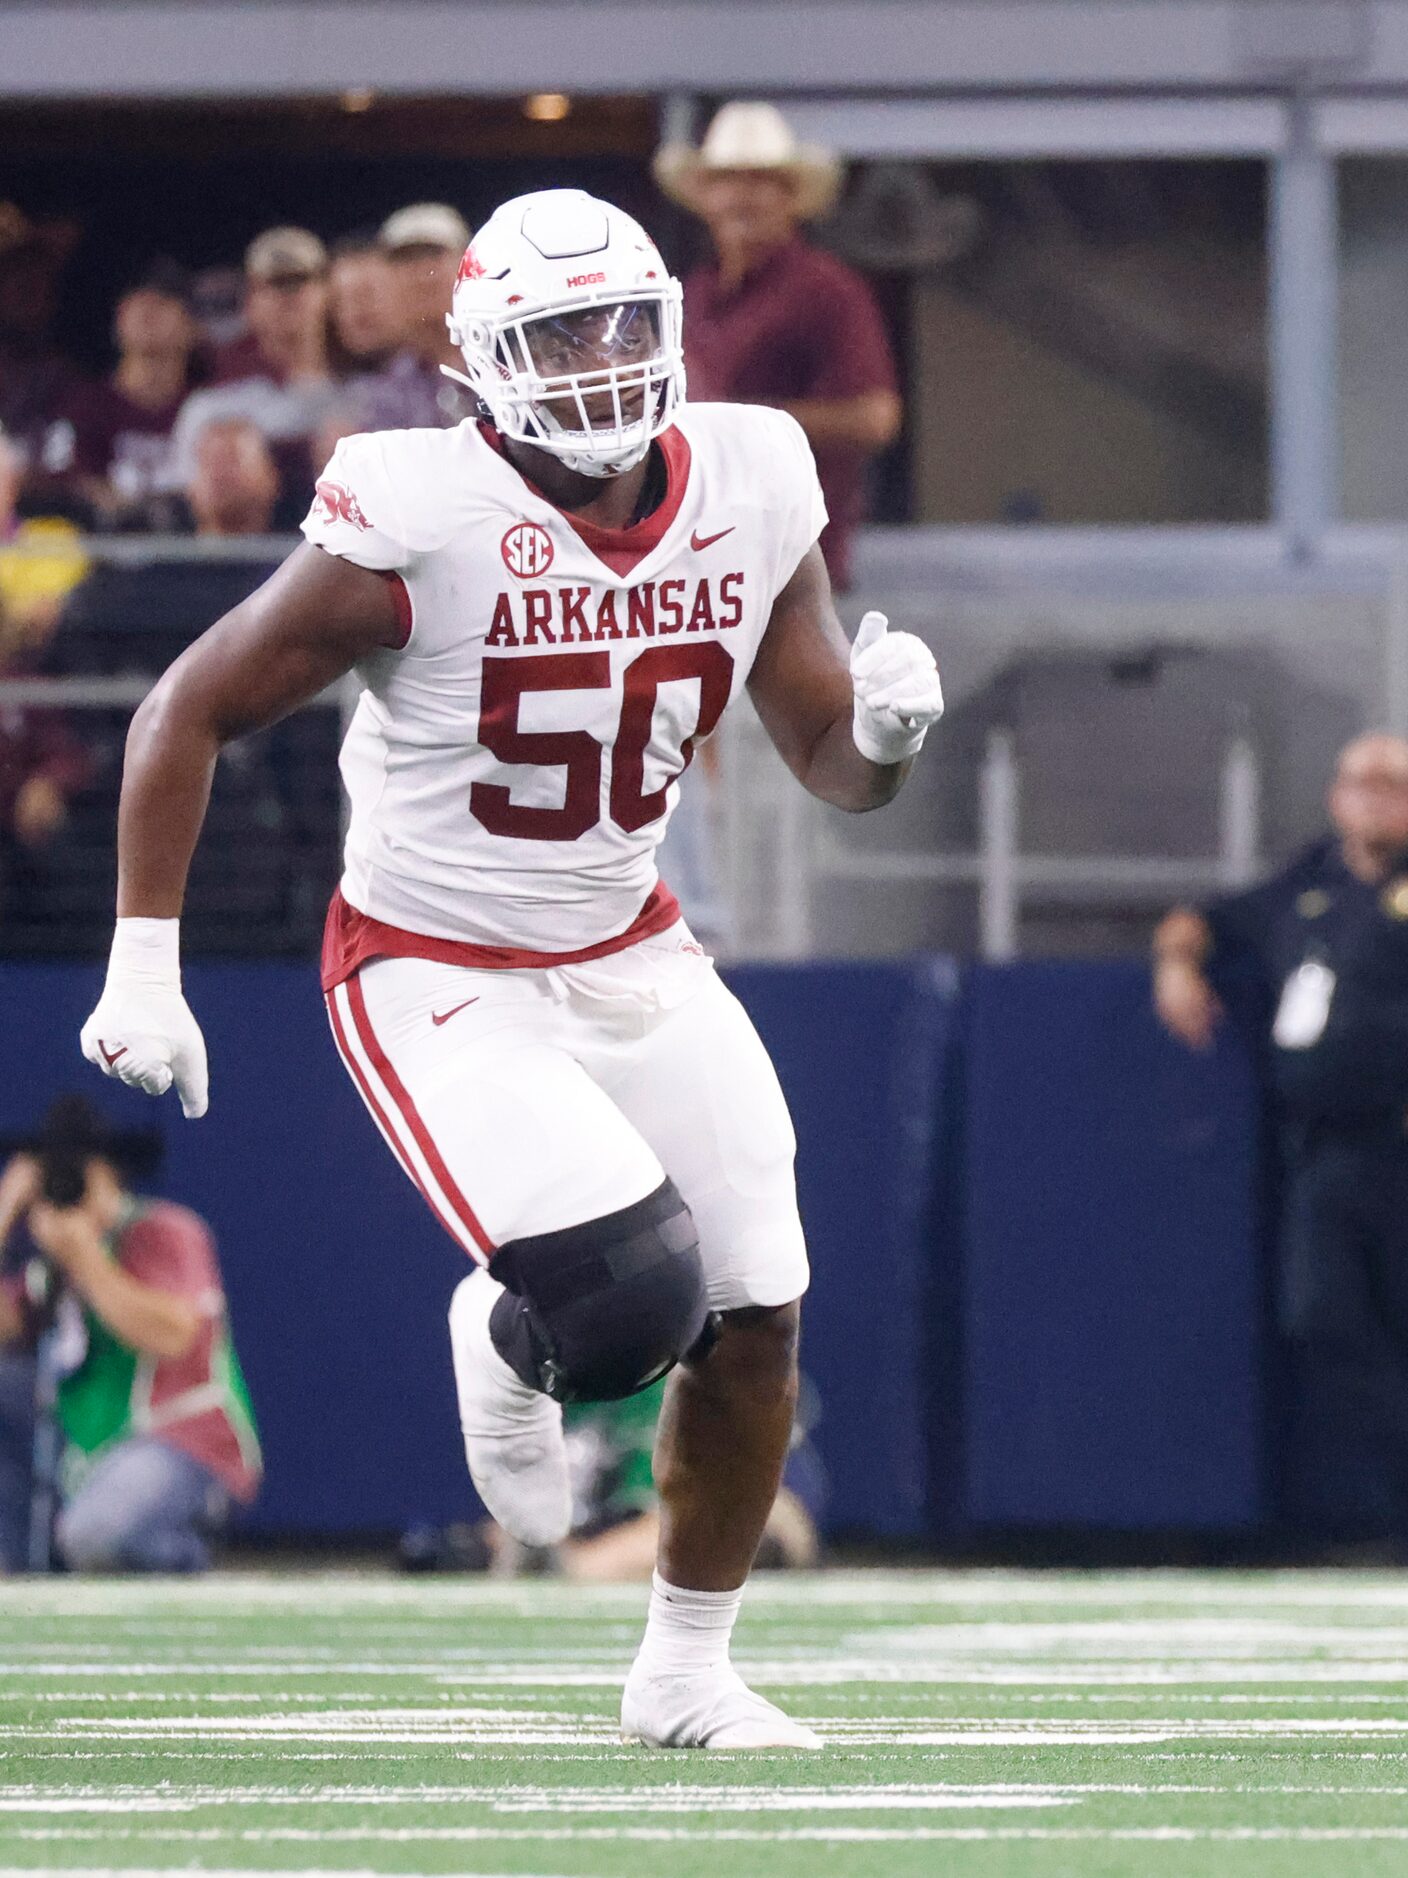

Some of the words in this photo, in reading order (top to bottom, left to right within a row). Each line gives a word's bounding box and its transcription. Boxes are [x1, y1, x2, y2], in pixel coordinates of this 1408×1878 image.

[566, 272, 606, 288] HOGS
[503, 524, 552, 576] SEC
[484, 572, 744, 647] ARKANSAS
[469, 640, 735, 841] 50
